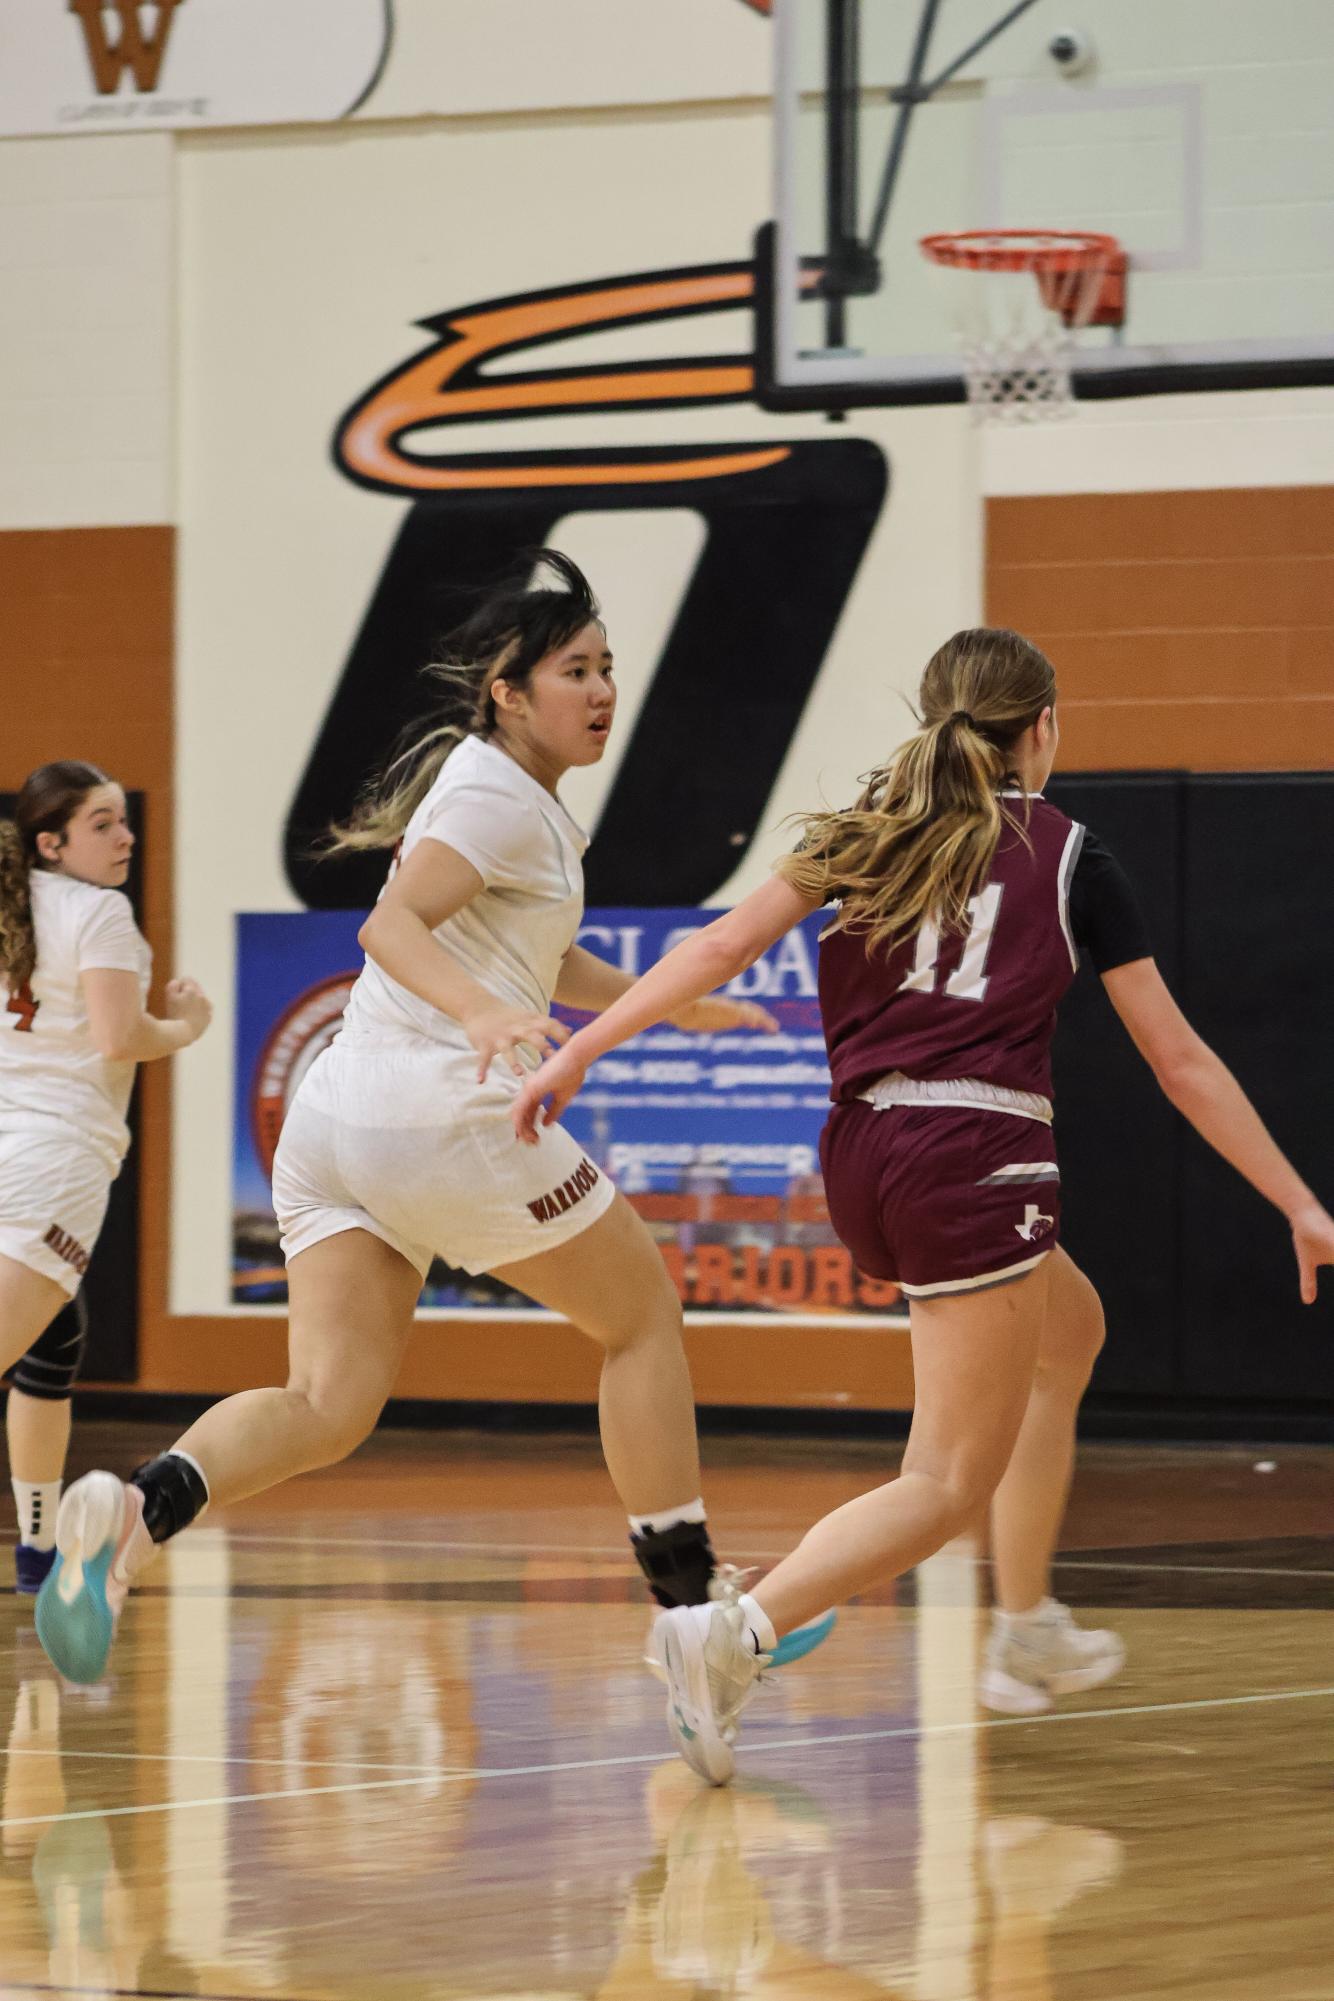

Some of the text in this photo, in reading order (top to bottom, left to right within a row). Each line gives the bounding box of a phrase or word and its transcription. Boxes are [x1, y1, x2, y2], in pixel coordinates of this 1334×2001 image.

[67, 0, 187, 94] W
[897, 881, 1005, 1002] 11
[526, 1157, 599, 1223] WARRIORS
